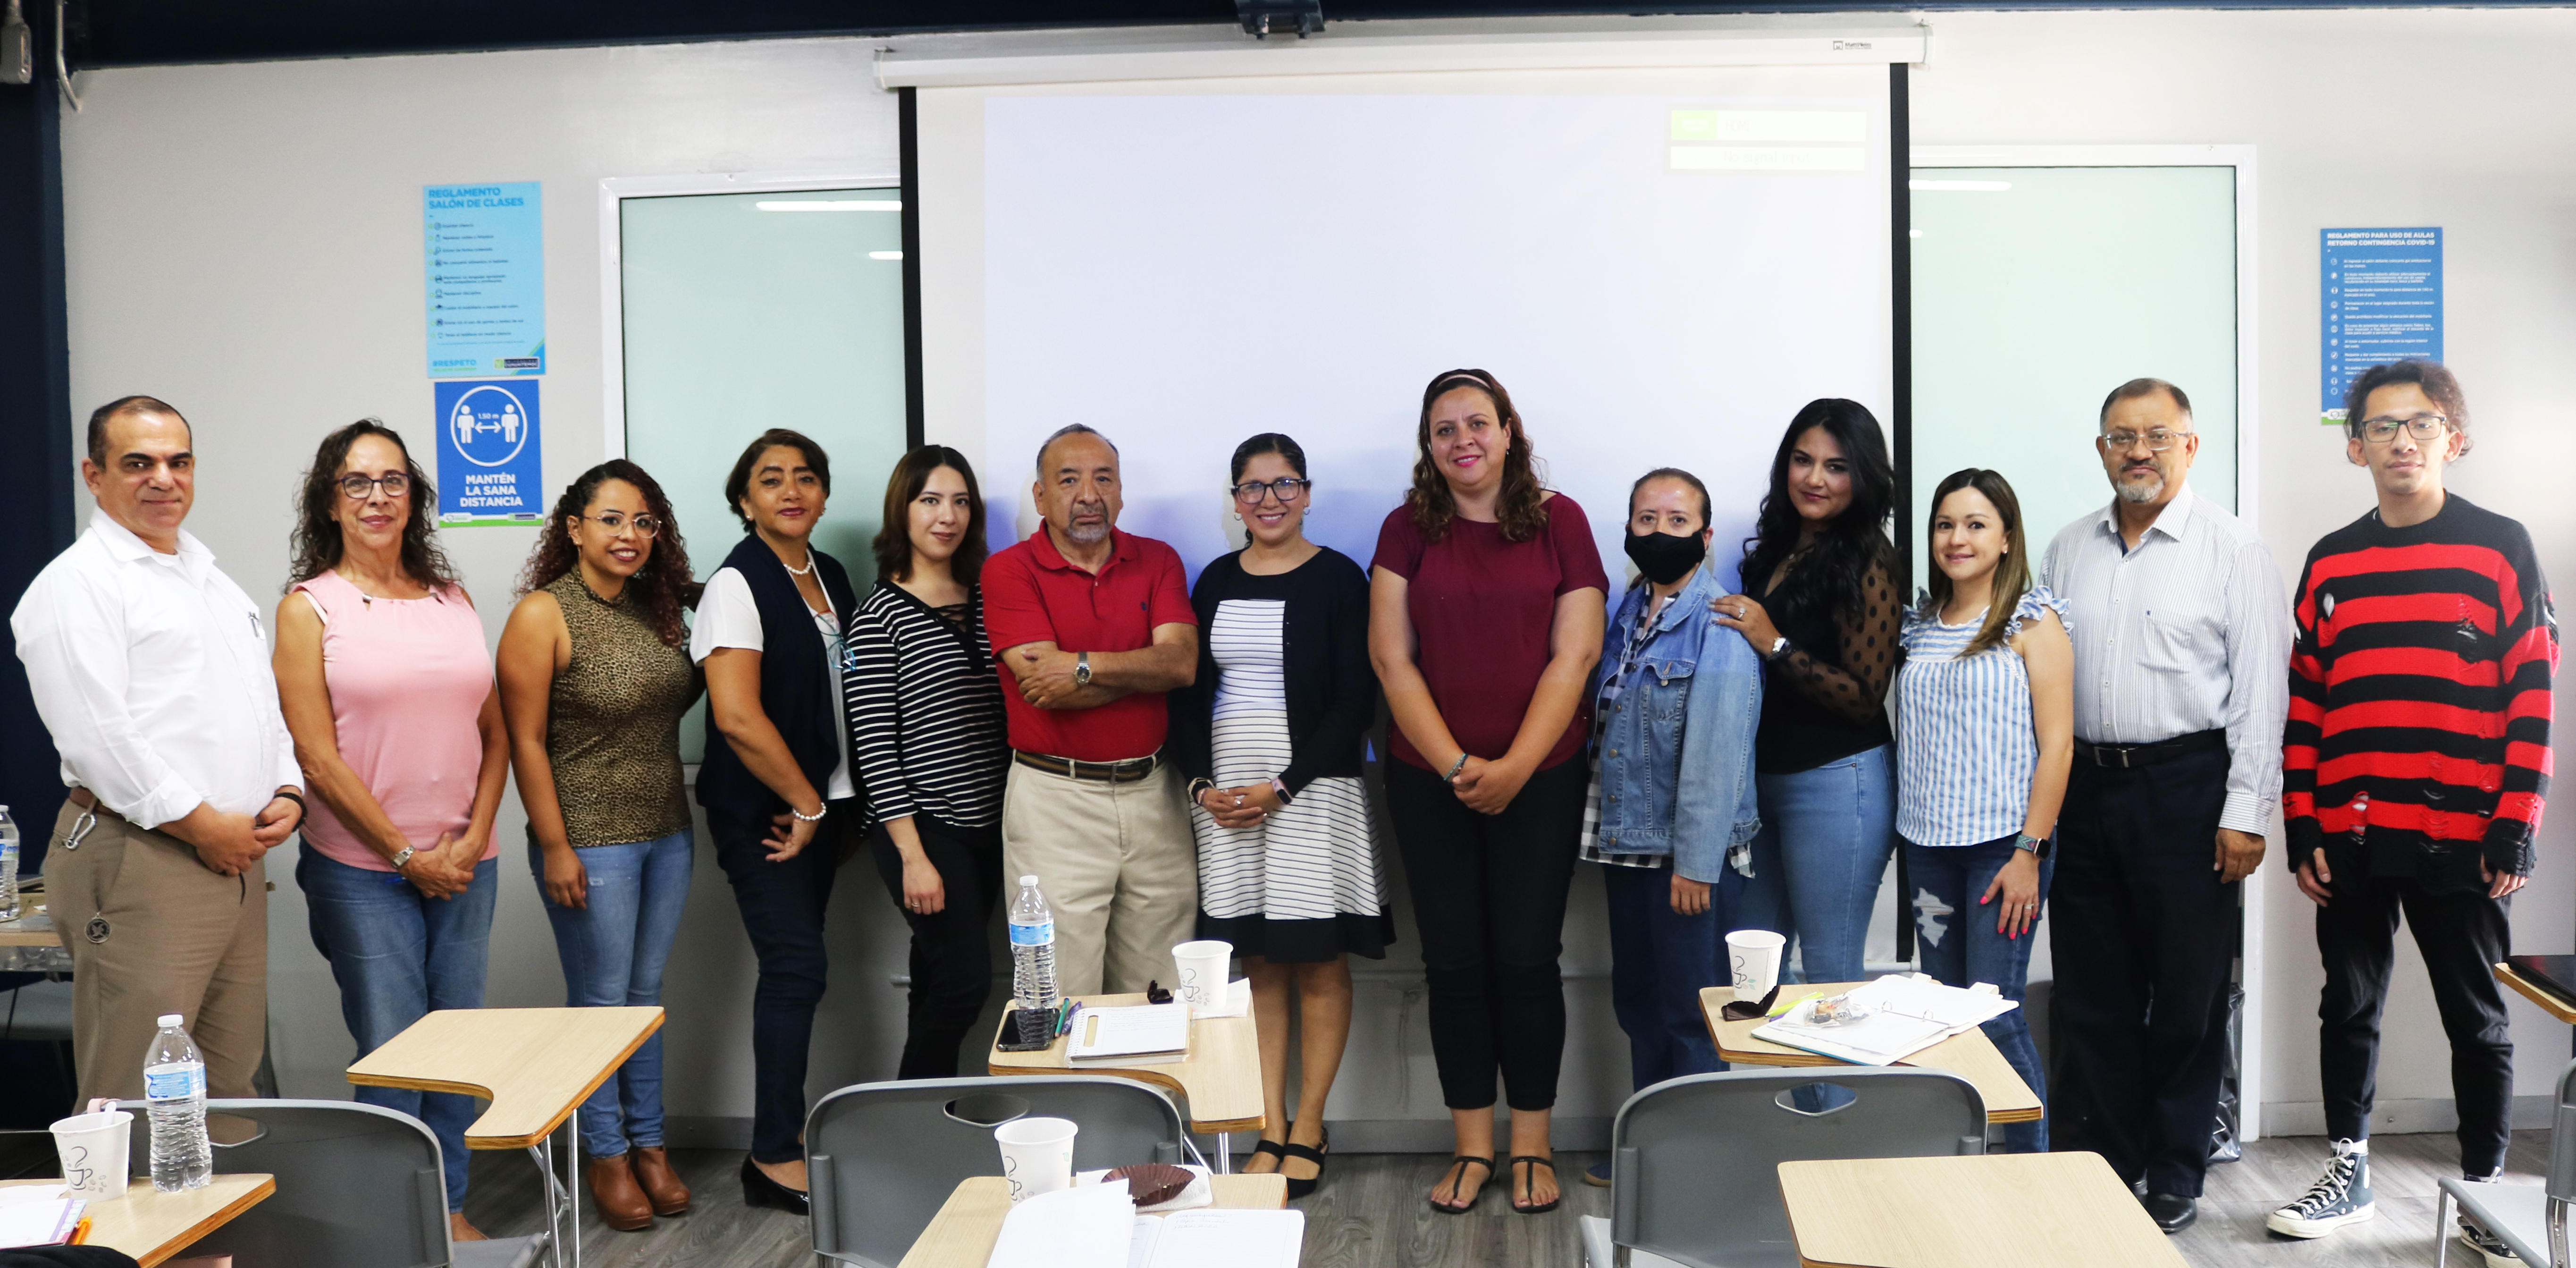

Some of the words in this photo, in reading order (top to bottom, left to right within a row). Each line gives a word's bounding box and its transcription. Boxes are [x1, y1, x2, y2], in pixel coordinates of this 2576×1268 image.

[1725, 119, 1750, 131] HDMI
[1723, 151, 1739, 161] No
[1743, 151, 1777, 165] signal
[1782, 152, 1810, 164] input
[429, 187, 500, 198] REGLAMENTO
[429, 198, 464, 209] SALÓN
[484, 198, 524, 207] CLASES
[465, 472, 515, 484] MANTÉN
[465, 486, 481, 496] LA
[483, 485, 516, 496] SANA
[460, 497, 523, 507] DISTANCIA
